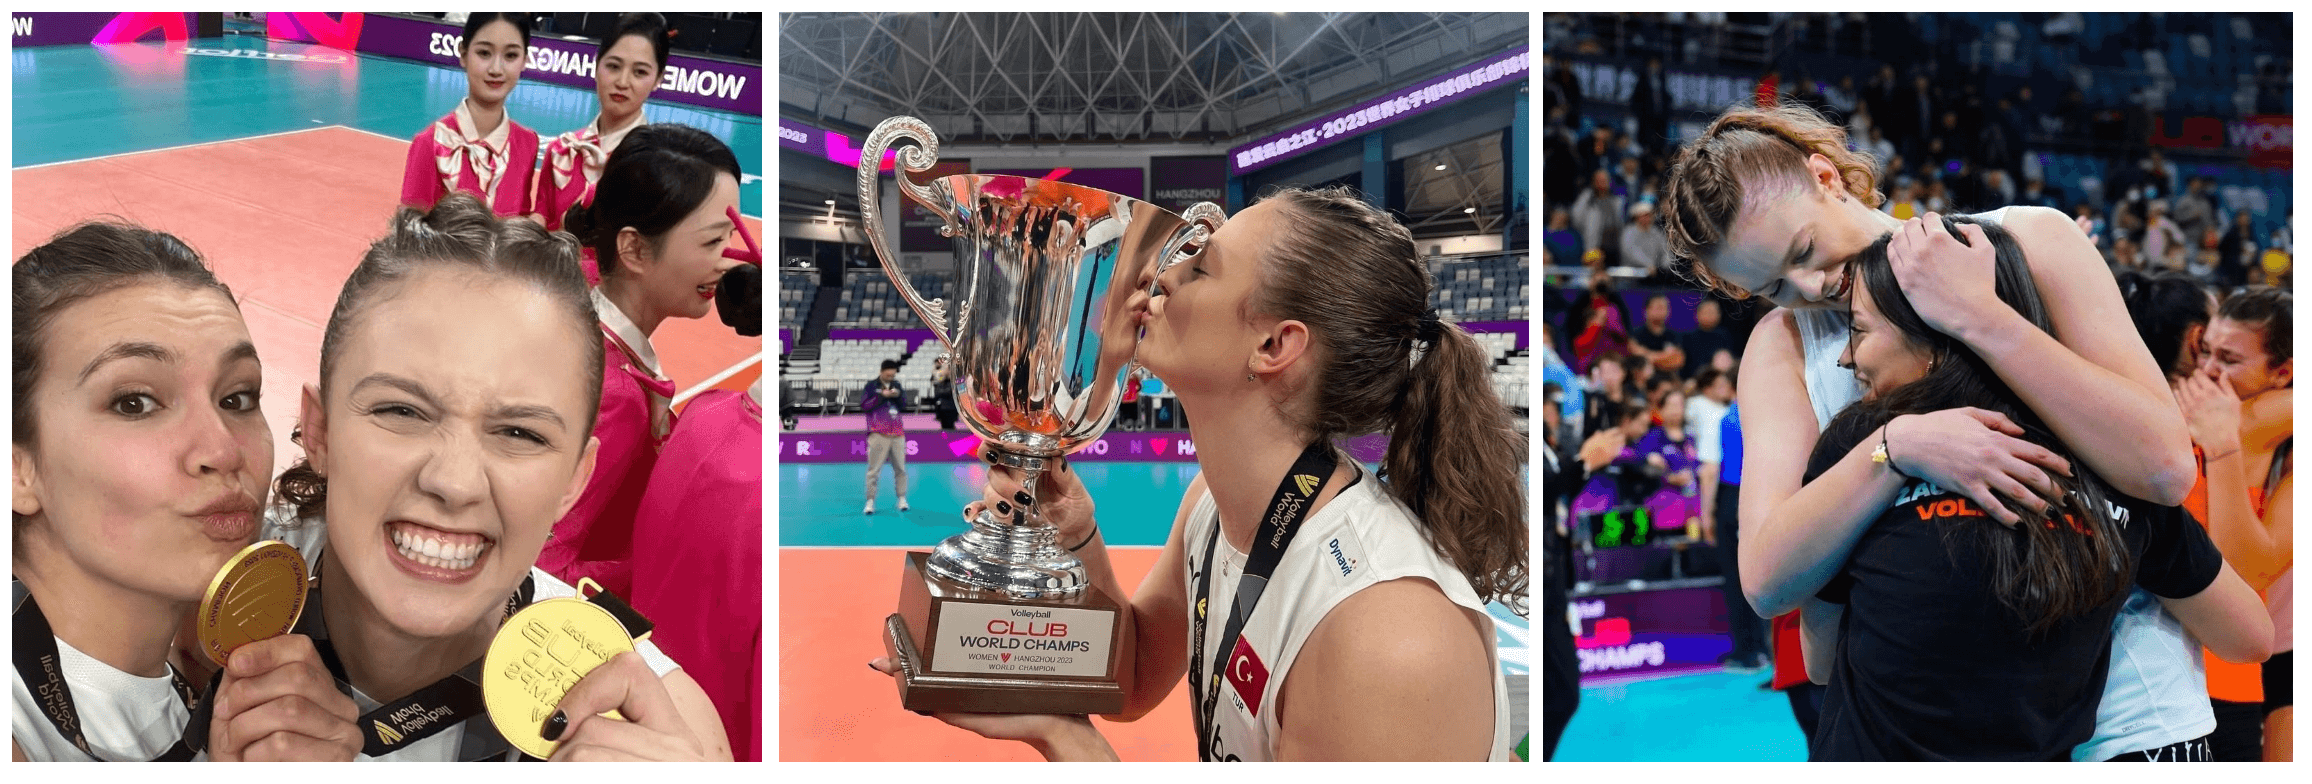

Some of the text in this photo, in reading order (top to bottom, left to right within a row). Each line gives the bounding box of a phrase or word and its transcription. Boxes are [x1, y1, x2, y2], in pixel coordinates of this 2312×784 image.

[1270, 492, 1295, 526] World
[1270, 498, 1304, 549] Volleyball
[1329, 538, 1352, 577] Dynavit
[1011, 608, 1051, 619] Volleyball
[987, 619, 1068, 637] CLUB
[960, 635, 1089, 652] WORLD CHAMPS
[968, 653, 1073, 664] WOMEN HANGZHOU 2023
[989, 663, 1055, 672] WORLD CHAMPION
[1233, 691, 1243, 713] TUR
